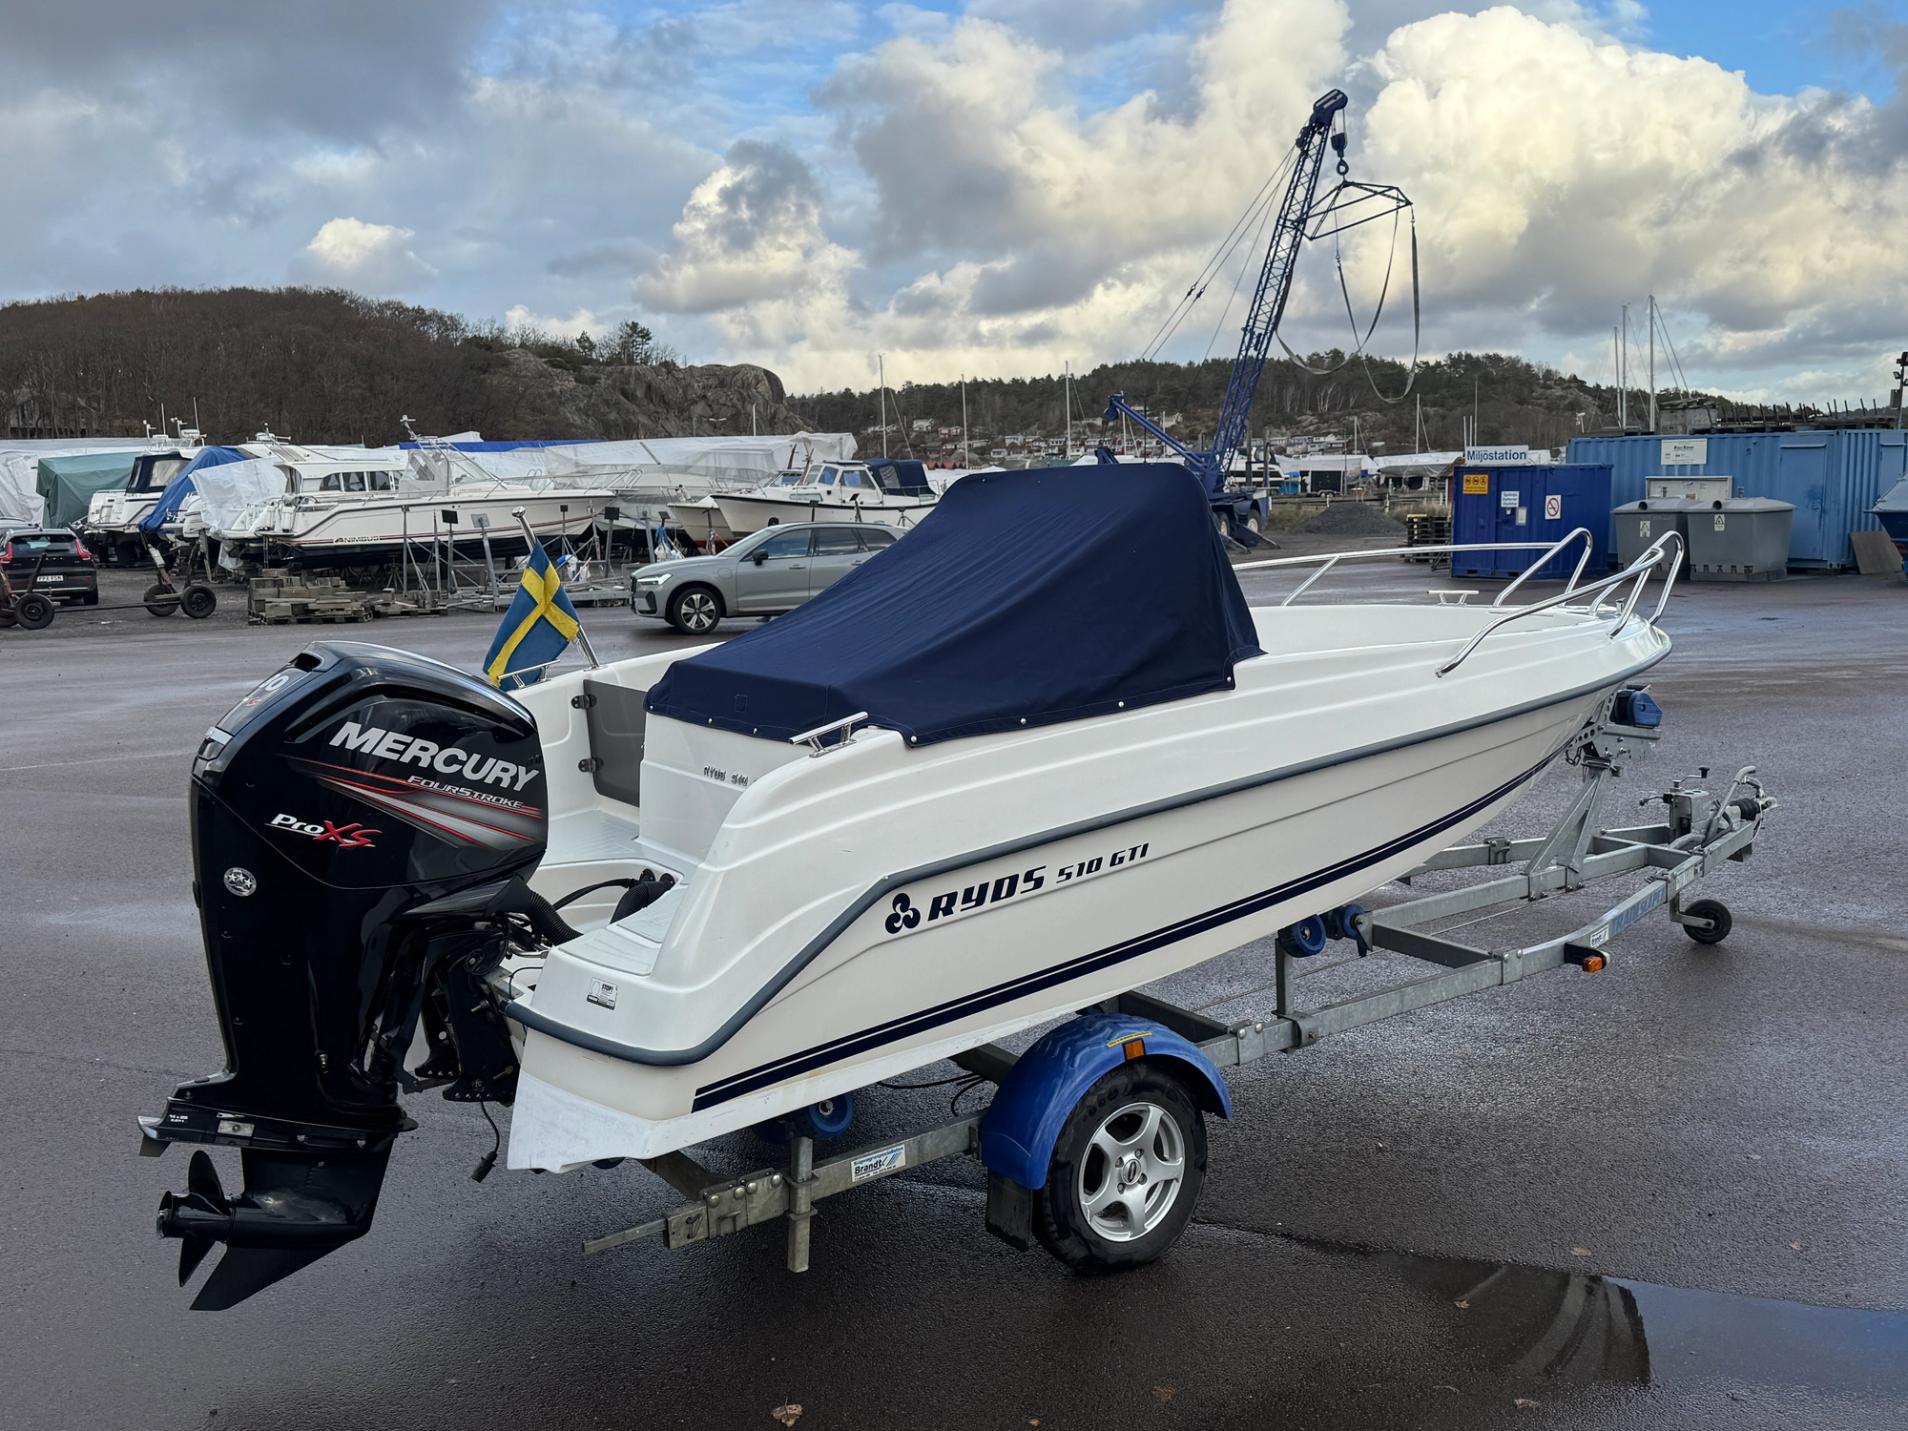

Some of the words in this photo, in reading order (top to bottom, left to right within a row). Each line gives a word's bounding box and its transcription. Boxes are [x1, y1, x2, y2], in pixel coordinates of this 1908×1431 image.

[1467, 449, 1527, 462] Miljöstation
[329, 721, 540, 793] MERCURY
[408, 774, 524, 809] FOURSTROKE
[268, 812, 384, 849] ProXS
[927, 864, 1047, 922] RYDS
[1055, 856, 1104, 884] 510
[1109, 842, 1150, 868] GTI
[855, 1160, 882, 1174] Brandt
